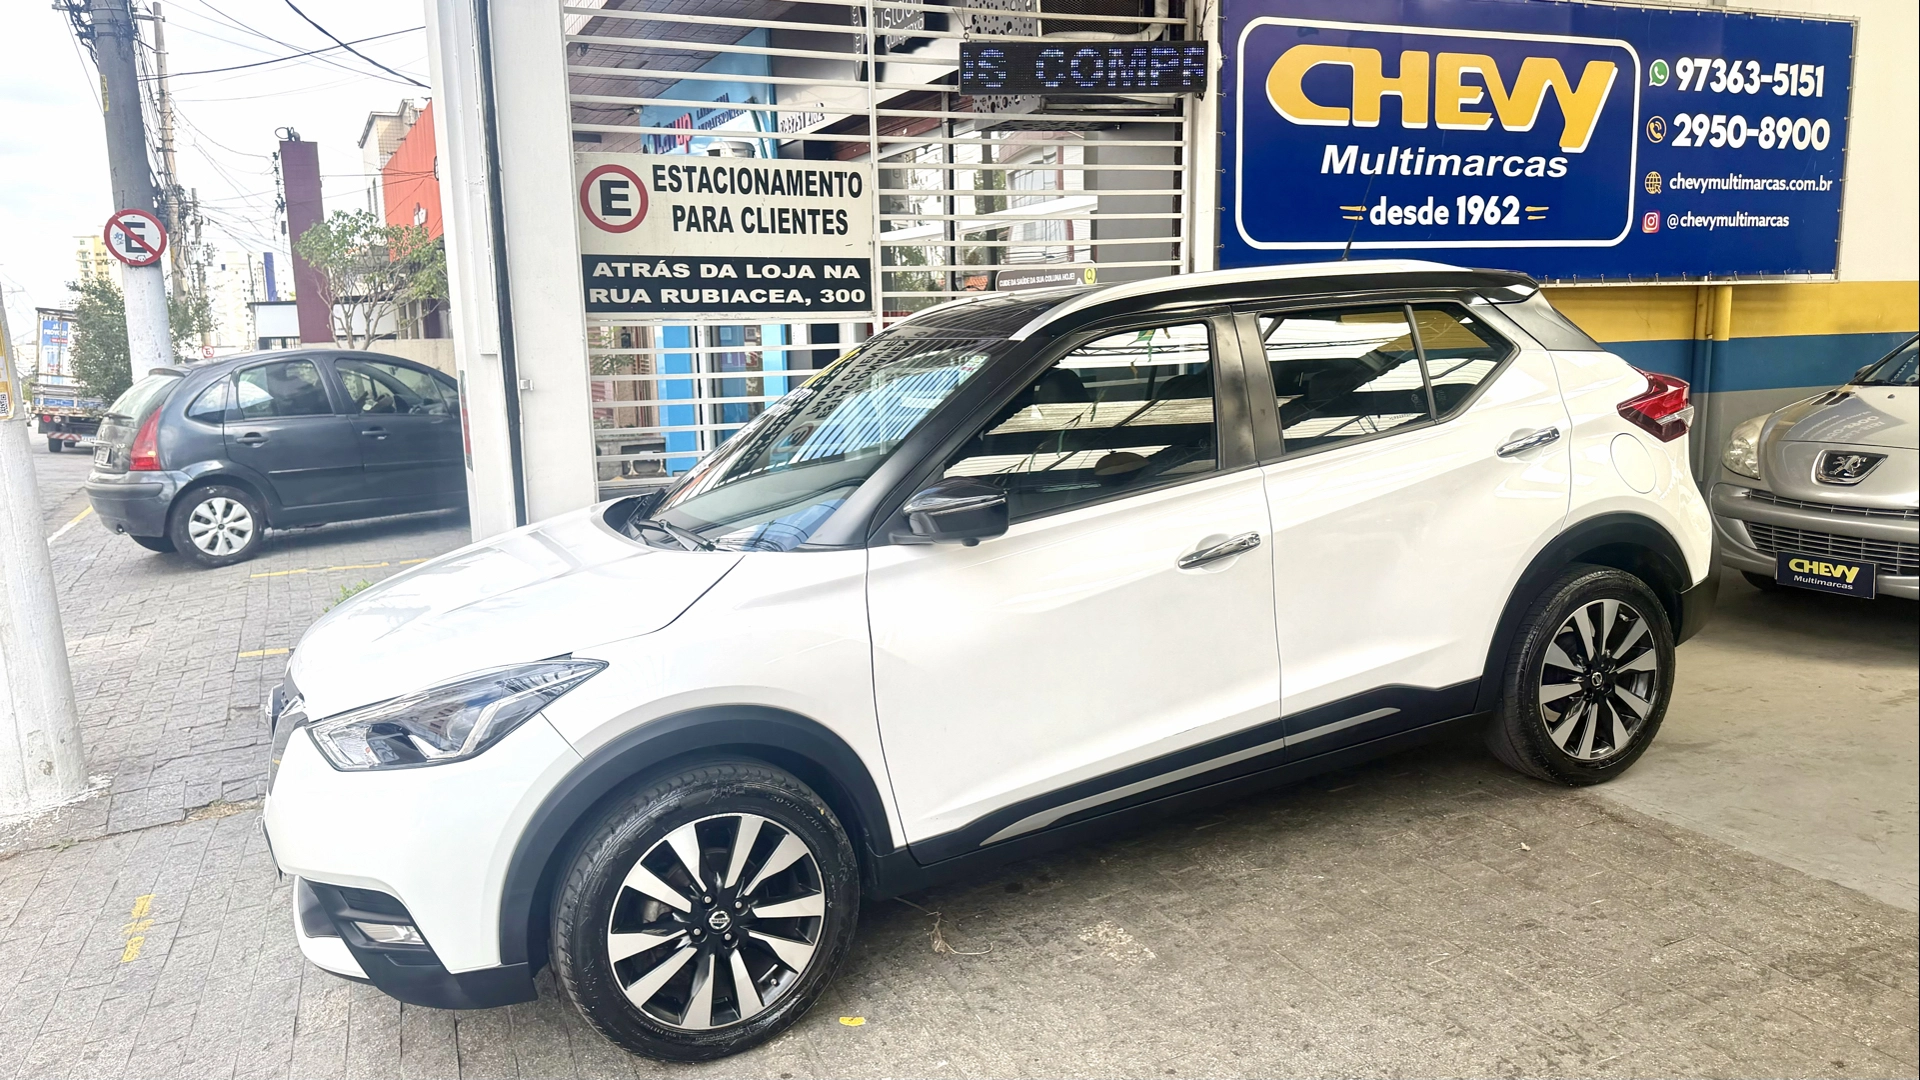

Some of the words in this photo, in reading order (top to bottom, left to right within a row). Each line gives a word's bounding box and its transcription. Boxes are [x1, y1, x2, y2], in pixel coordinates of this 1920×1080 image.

[1675, 57, 1824, 98] 97363-5151
[1265, 43, 1618, 153] CHEVY
[1671, 114, 1830, 152] 2950-8900
[1320, 144, 1569, 178] Multimarcas
[652, 164, 863, 198] ESTACIONAMENTO
[1669, 174, 1833, 194] chevymultimarcas.com.br
[599, 179, 632, 217] E
[1369, 198, 1450, 226] desde
[1455, 196, 1520, 225] 1962
[672, 205, 734, 233] PARA
[741, 206, 849, 235] CLIENTES
[124, 222, 147, 253] E
[592, 260, 691, 278] ATRÁS
[700, 263, 738, 278] DA
[746, 264, 816, 279] LOJA
[824, 265, 861, 279] NA
[589, 288, 652, 303] RUA
[660, 289, 811, 307] RUBIACEA,
[820, 289, 866, 303] 300
[1788, 558, 1860, 583] CHEVY
[1793, 575, 1854, 590] Multimarcas
